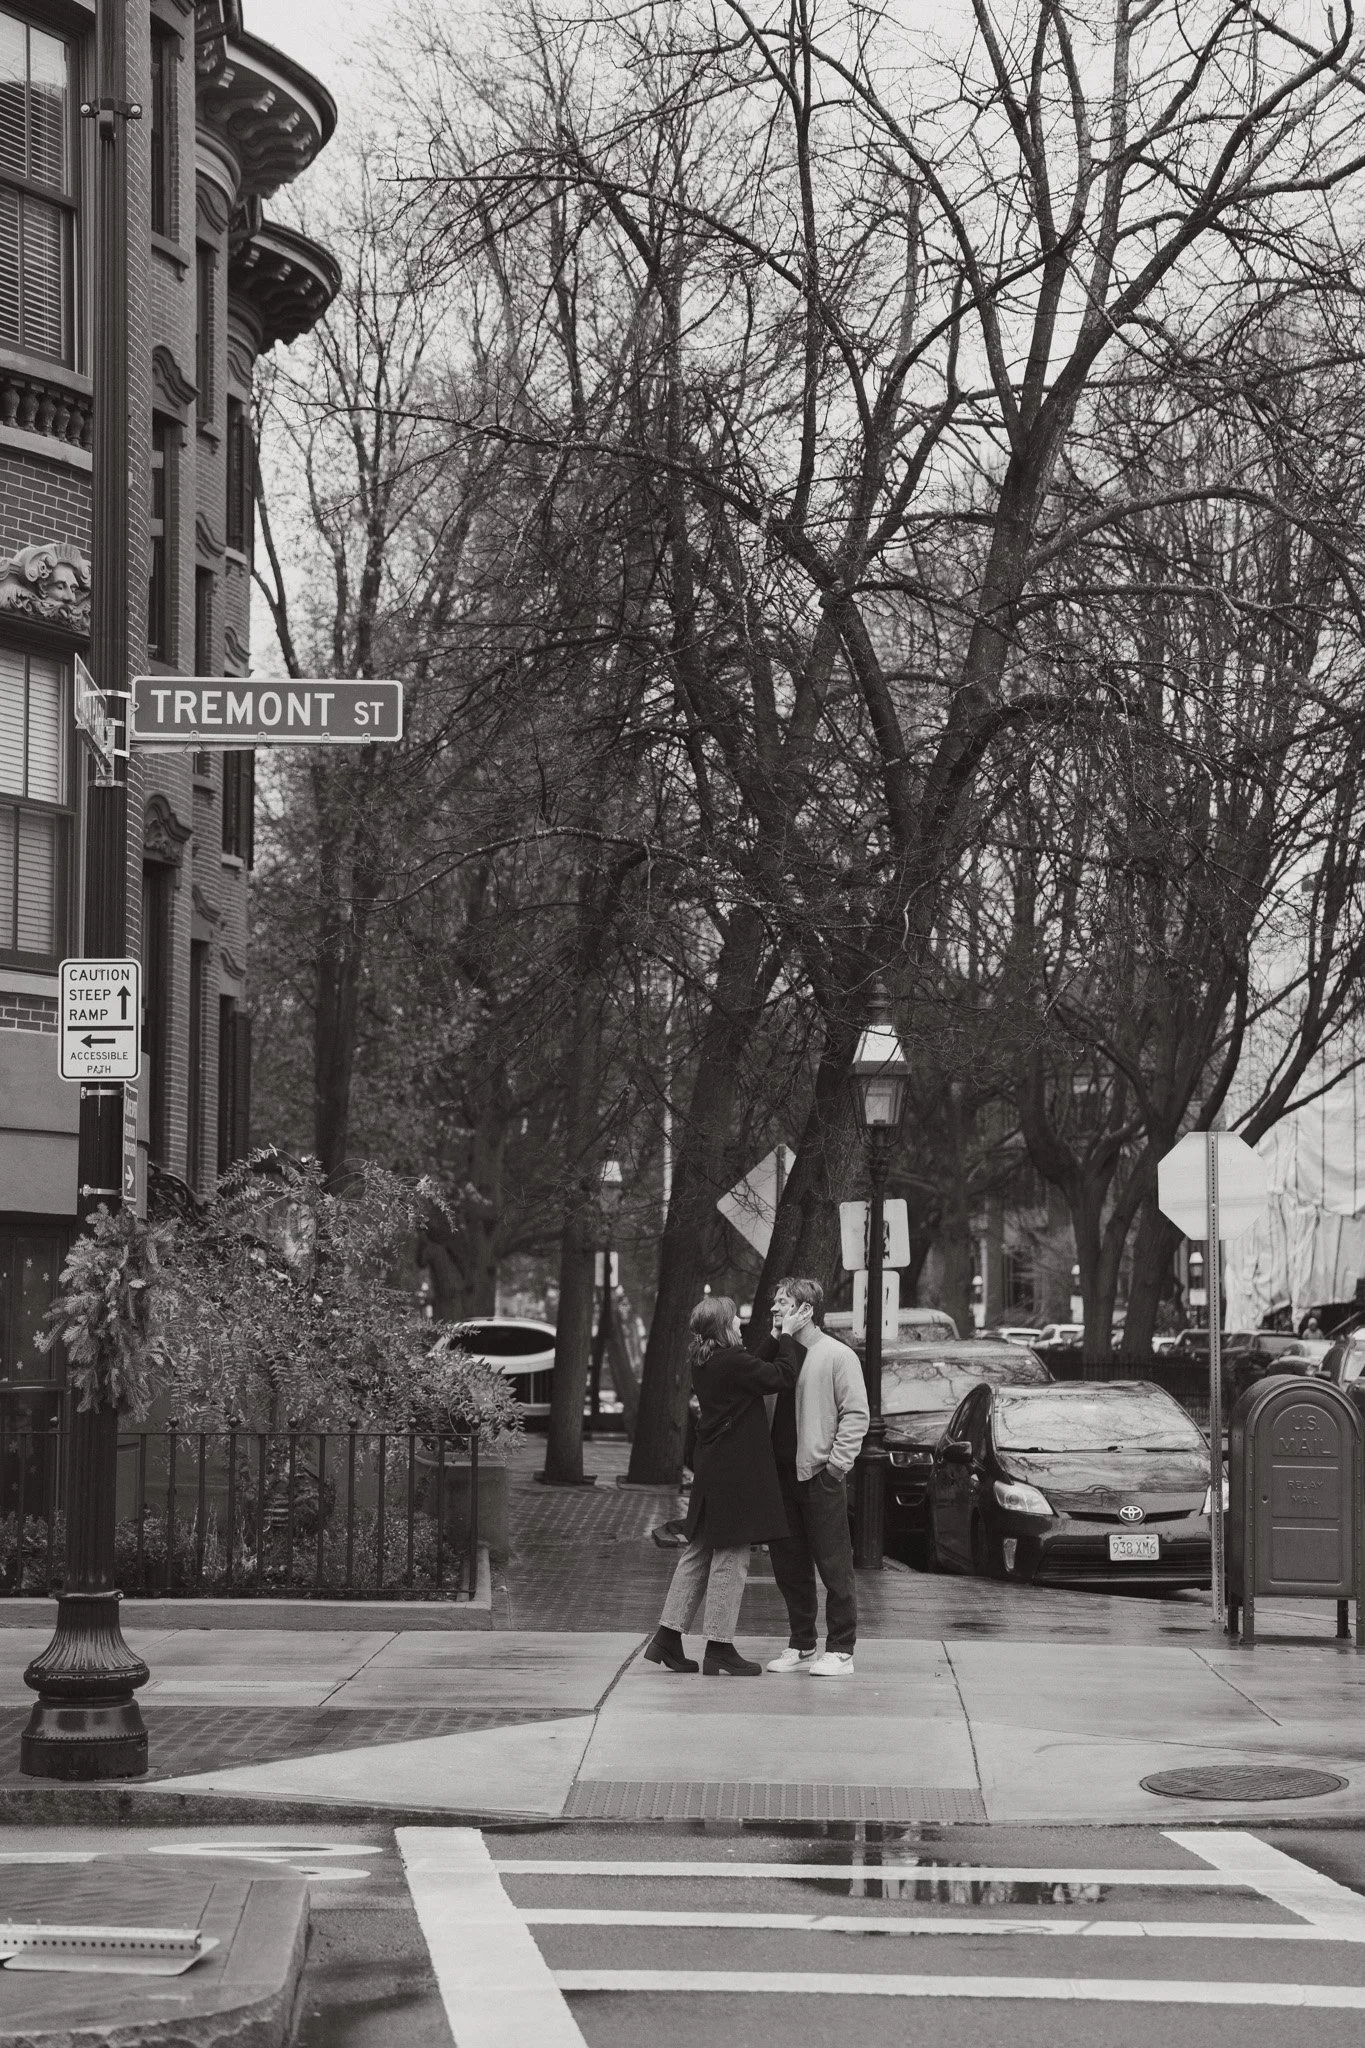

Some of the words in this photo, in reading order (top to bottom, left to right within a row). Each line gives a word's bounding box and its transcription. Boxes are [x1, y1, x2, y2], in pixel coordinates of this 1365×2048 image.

[150, 689, 335, 726] TREMONT
[353, 701, 385, 726] ST
[69, 969, 130, 981] CAUTION
[69, 989, 111, 1001] STEEP
[69, 1009, 109, 1021] RAMP
[70, 1051, 129, 1060] ACCESSIBLE
[87, 1065, 112, 1074] PATH
[1292, 1413, 1321, 1431] U.S.
[1279, 1437, 1332, 1455] MAIL
[1112, 1541, 1133, 1554] 938
[1136, 1541, 1156, 1554] XM6
